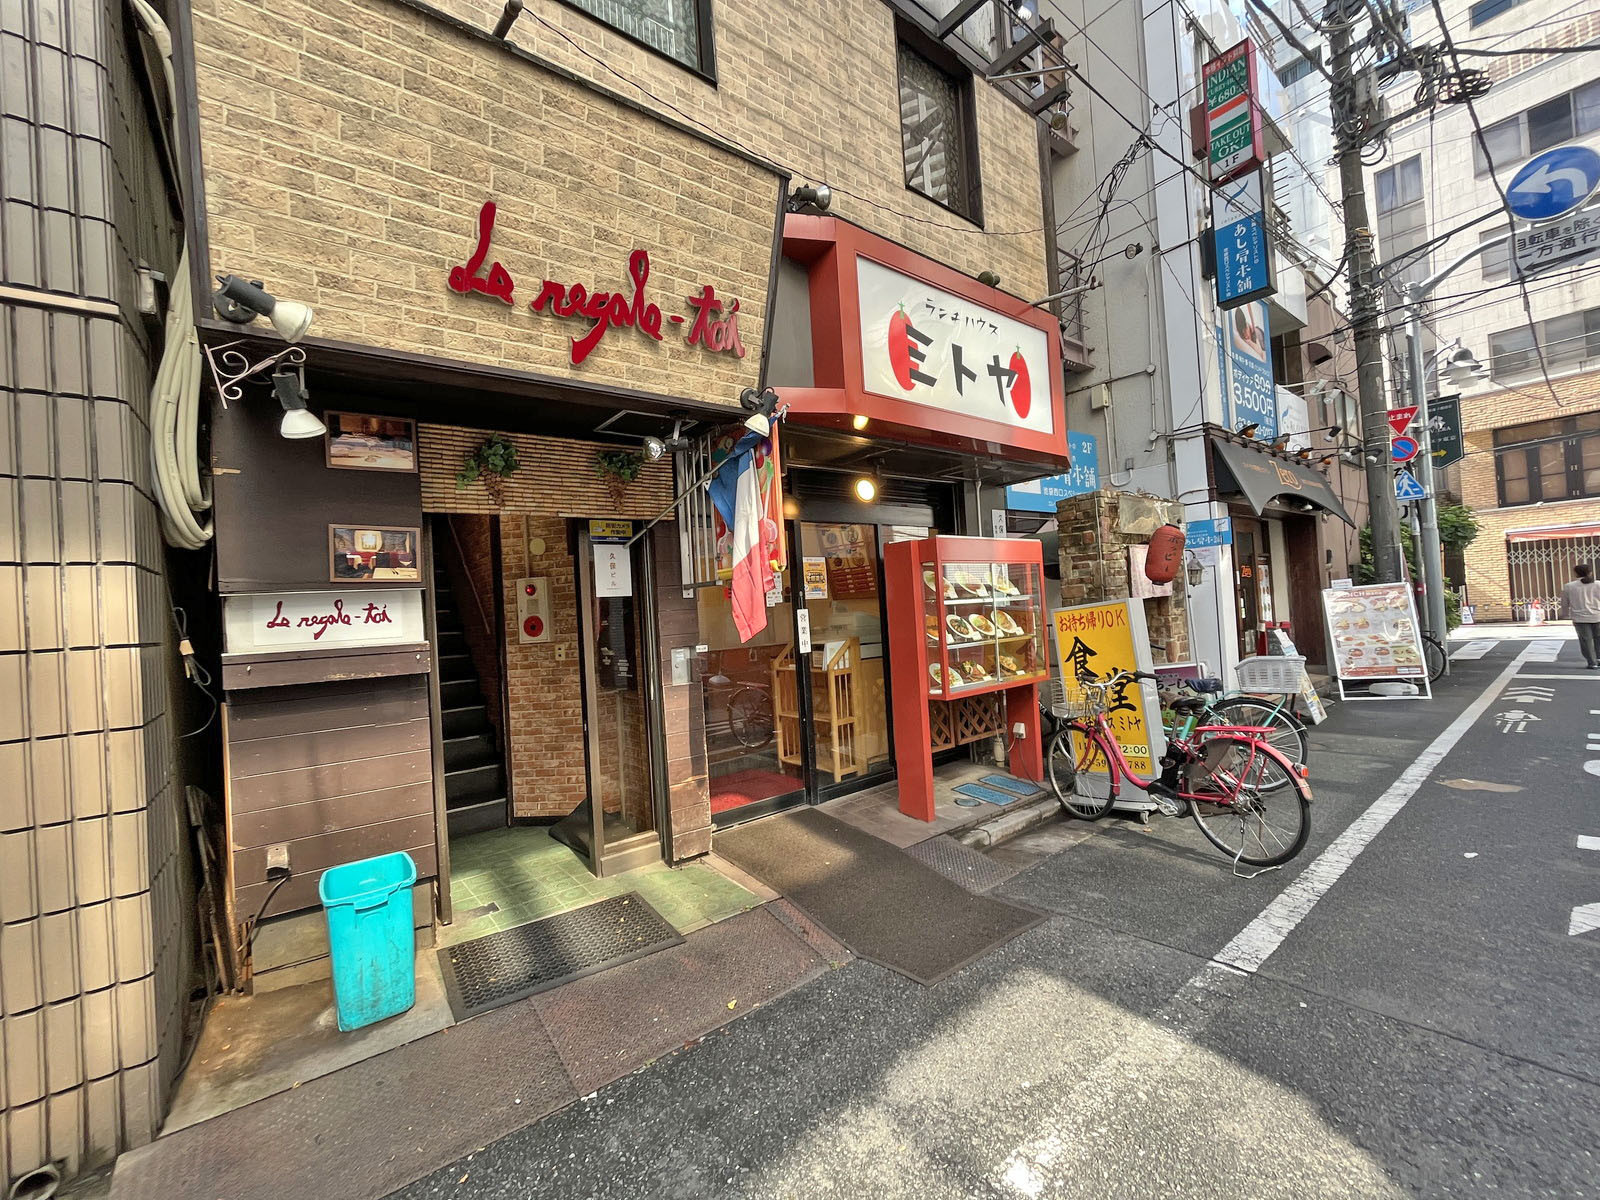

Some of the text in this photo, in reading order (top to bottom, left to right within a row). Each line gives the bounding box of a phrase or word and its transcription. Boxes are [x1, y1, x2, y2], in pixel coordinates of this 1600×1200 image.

[1207, 57, 1246, 88] INDIAN
[1211, 123, 1250, 151] TAKE OUT
[1218, 136, 1244, 158] OK!
[1234, 224, 1252, 293] あし肩本舗
[1518, 229, 1600, 259] 一方通行
[925, 298, 999, 335] ランチハウス
[905, 323, 1018, 407] ミトヤ
[1233, 382, 1274, 418] 3,500円
[1388, 412, 1411, 421] 止まれ
[1081, 441, 1093, 454] 2F
[609, 552, 617, 587] 久保ビル
[800, 613, 809, 648] 営業中
[1059, 608, 1126, 633] お持ち帰りOK
